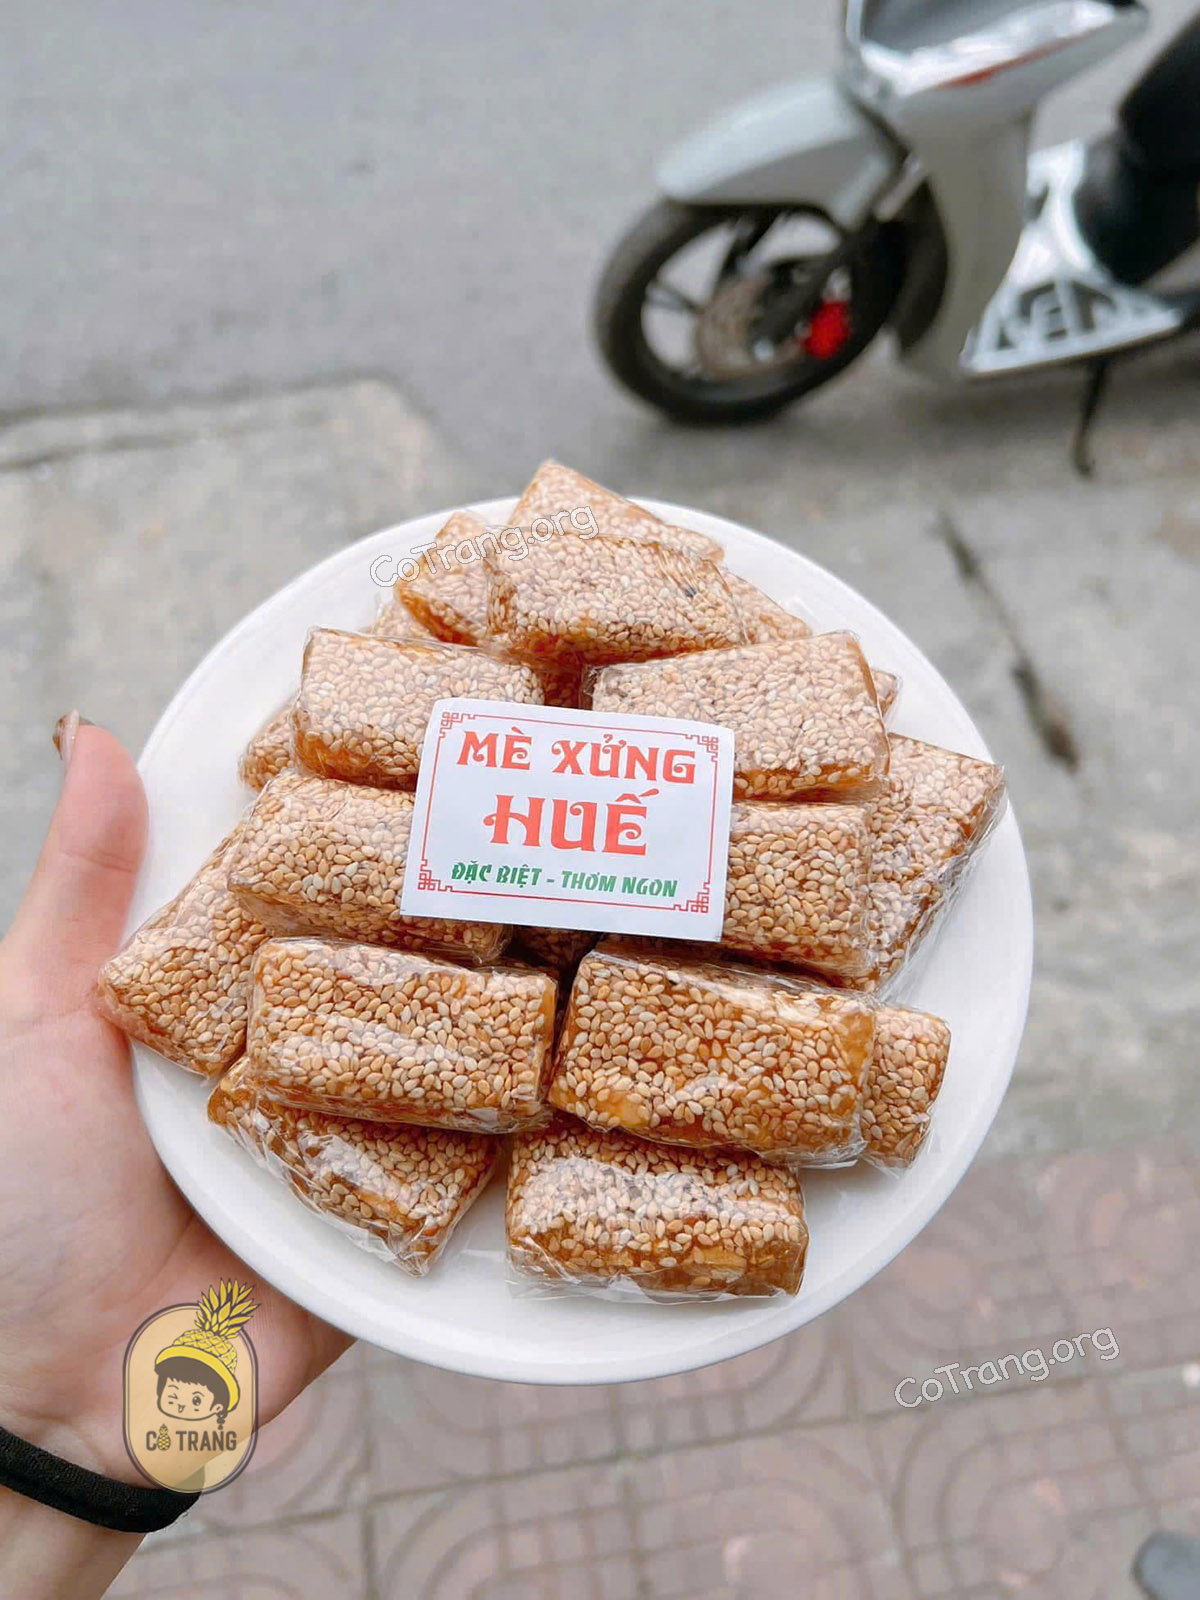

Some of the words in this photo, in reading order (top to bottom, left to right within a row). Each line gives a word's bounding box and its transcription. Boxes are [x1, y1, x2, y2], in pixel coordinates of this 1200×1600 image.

[456, 726, 532, 771] MÈ
[551, 733, 696, 784] XỬNG
[483, 788, 660, 856] HUẾ
[451, 860, 492, 884] ĐẶC
[496, 863, 542, 888] BIỆT
[561, 870, 618, 893] THƠM
[621, 876, 678, 898] NGON
